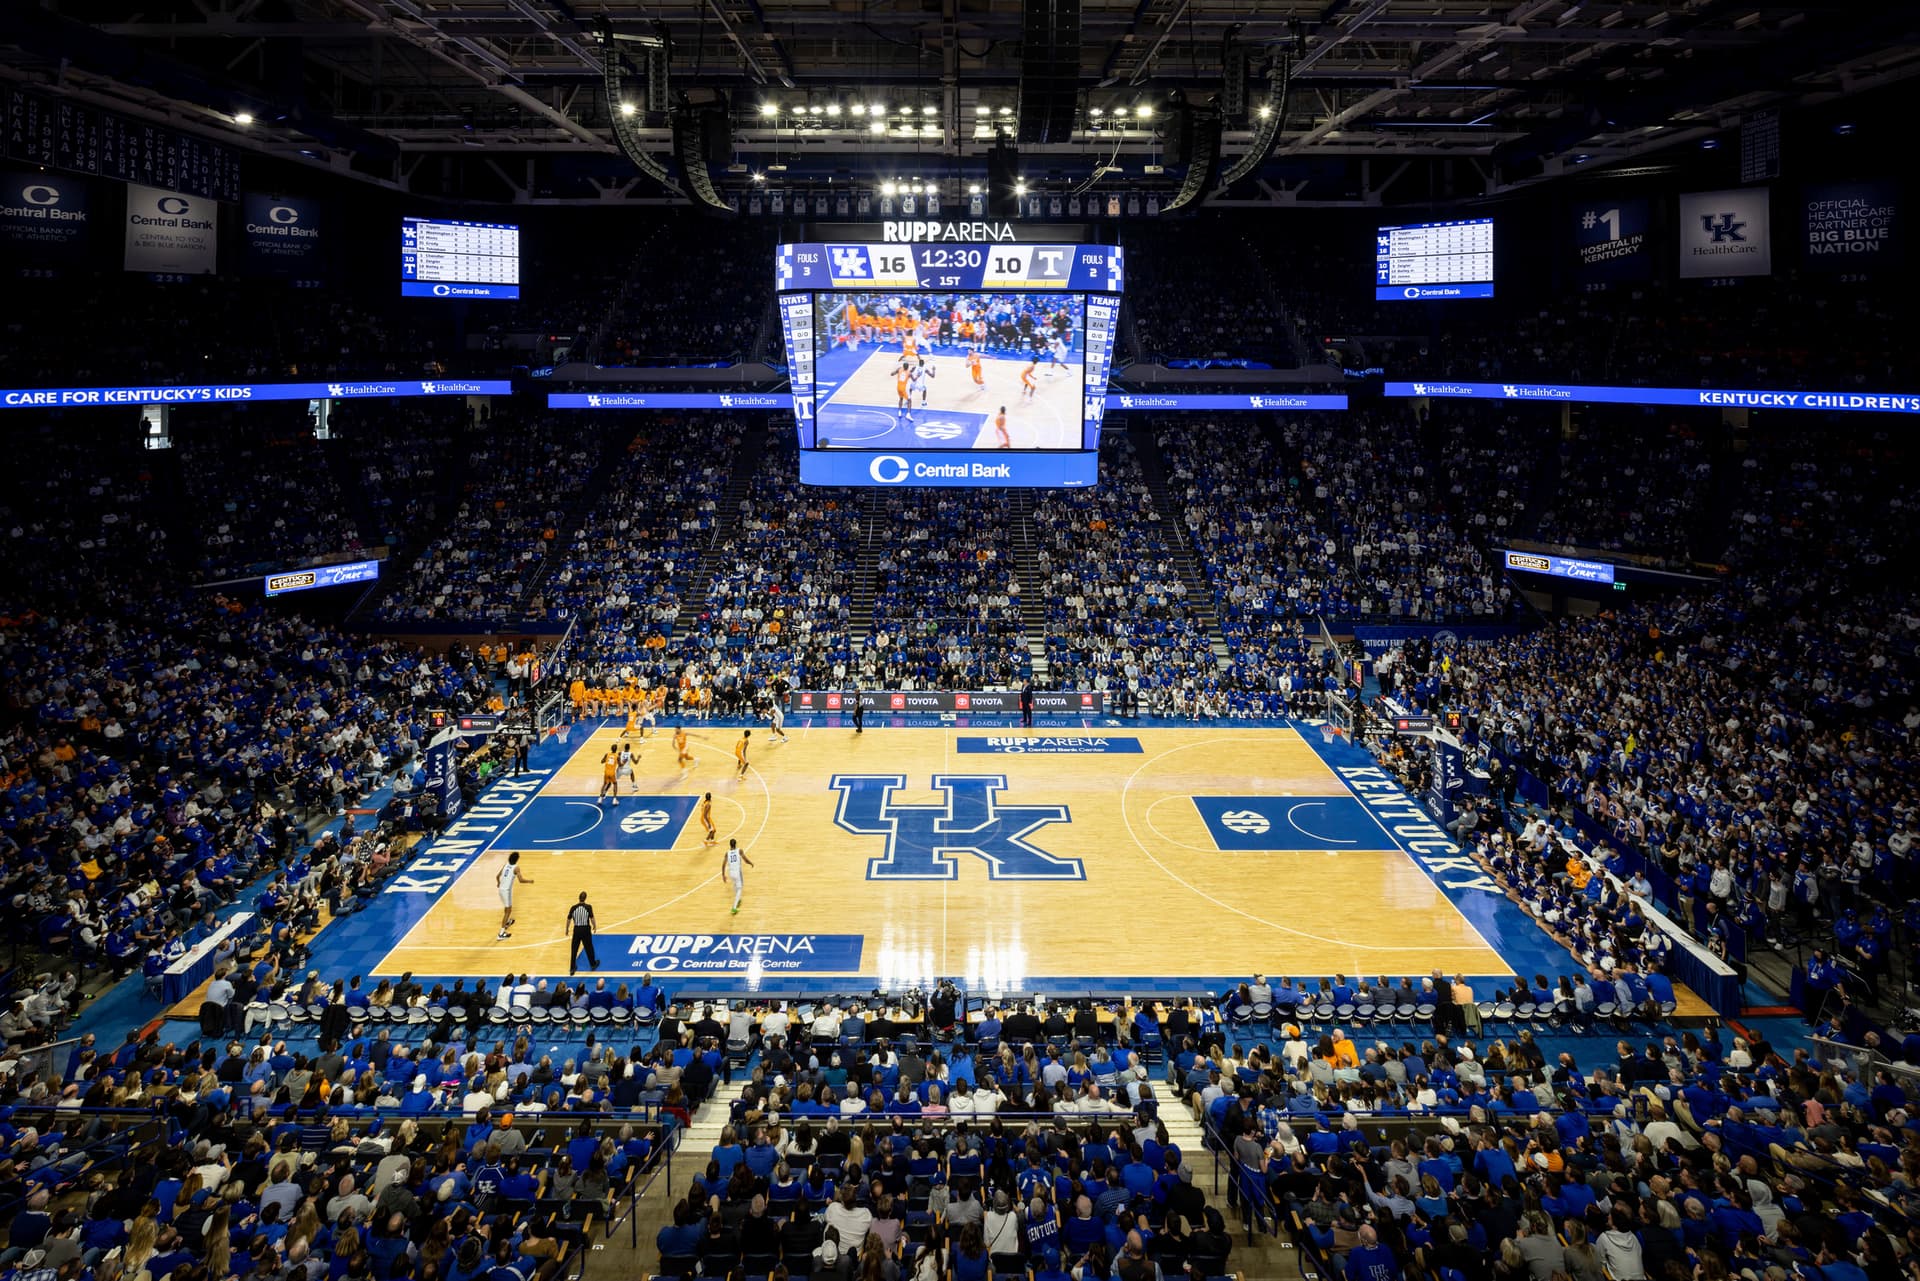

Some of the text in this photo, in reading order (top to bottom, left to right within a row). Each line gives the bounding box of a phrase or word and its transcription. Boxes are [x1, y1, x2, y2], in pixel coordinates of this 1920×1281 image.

[1808, 199, 1870, 211] OFFICIAL
[50, 208, 88, 222] Bank
[1808, 206, 1896, 220] HEALTHCARE
[130, 215, 213, 230] Central Bank
[1581, 209, 1620, 240] #1
[1808, 217, 1892, 231] PARTNER OF
[246, 223, 319, 238] Central Bank
[883, 221, 1016, 242] RUPP ARENA
[1809, 228, 1889, 242] BIG BLUE
[139, 233, 173, 242] CENTRAL
[176, 242, 206, 251] NATION
[1580, 234, 1643, 256] HOSPITAL IN
[1693, 245, 1758, 256] HealthCare
[1809, 240, 1880, 255] NATION
[797, 253, 818, 263] FOULS
[920, 250, 981, 268] 12:30
[1082, 254, 1103, 265] FOULS
[1584, 244, 1640, 264] KENTUCKY
[880, 257, 906, 273] 16
[995, 257, 1021, 273] 10
[803, 267, 811, 276] 3
[1090, 268, 1097, 277] 2
[939, 276, 961, 286] 1ST
[451, 287, 490, 295] Central Bank
[345, 385, 396, 394] HealthCare
[437, 383, 481, 392] HealthCare
[1427, 385, 1472, 394] HealthCare
[1520, 387, 1571, 397] HealthCare
[5, 387, 252, 405] CARE FOR KENTUCKY'S KIDS
[602, 397, 645, 405] HealthCare
[734, 397, 777, 405] HealthCare
[1135, 397, 1177, 406] HealthCare
[1265, 397, 1308, 406] HealthCare
[1699, 392, 1920, 409] KENTUCKY CHILDREN'S
[914, 462, 1010, 478] Central Bank
[333, 571, 362, 583] Crave
[1567, 565, 1597, 578] Crave
[907, 697, 938, 705] TOYOTA
[987, 737, 1109, 746] RUPP ARENA
[619, 810, 670, 834] SEC
[384, 768, 552, 894] KENTUCKY
[1336, 766, 1504, 894] KENTUCKY
[729, 854, 737, 863] 10
[628, 936, 814, 954] RUPP ARENA
[631, 959, 801, 968] at Central Ban Center
